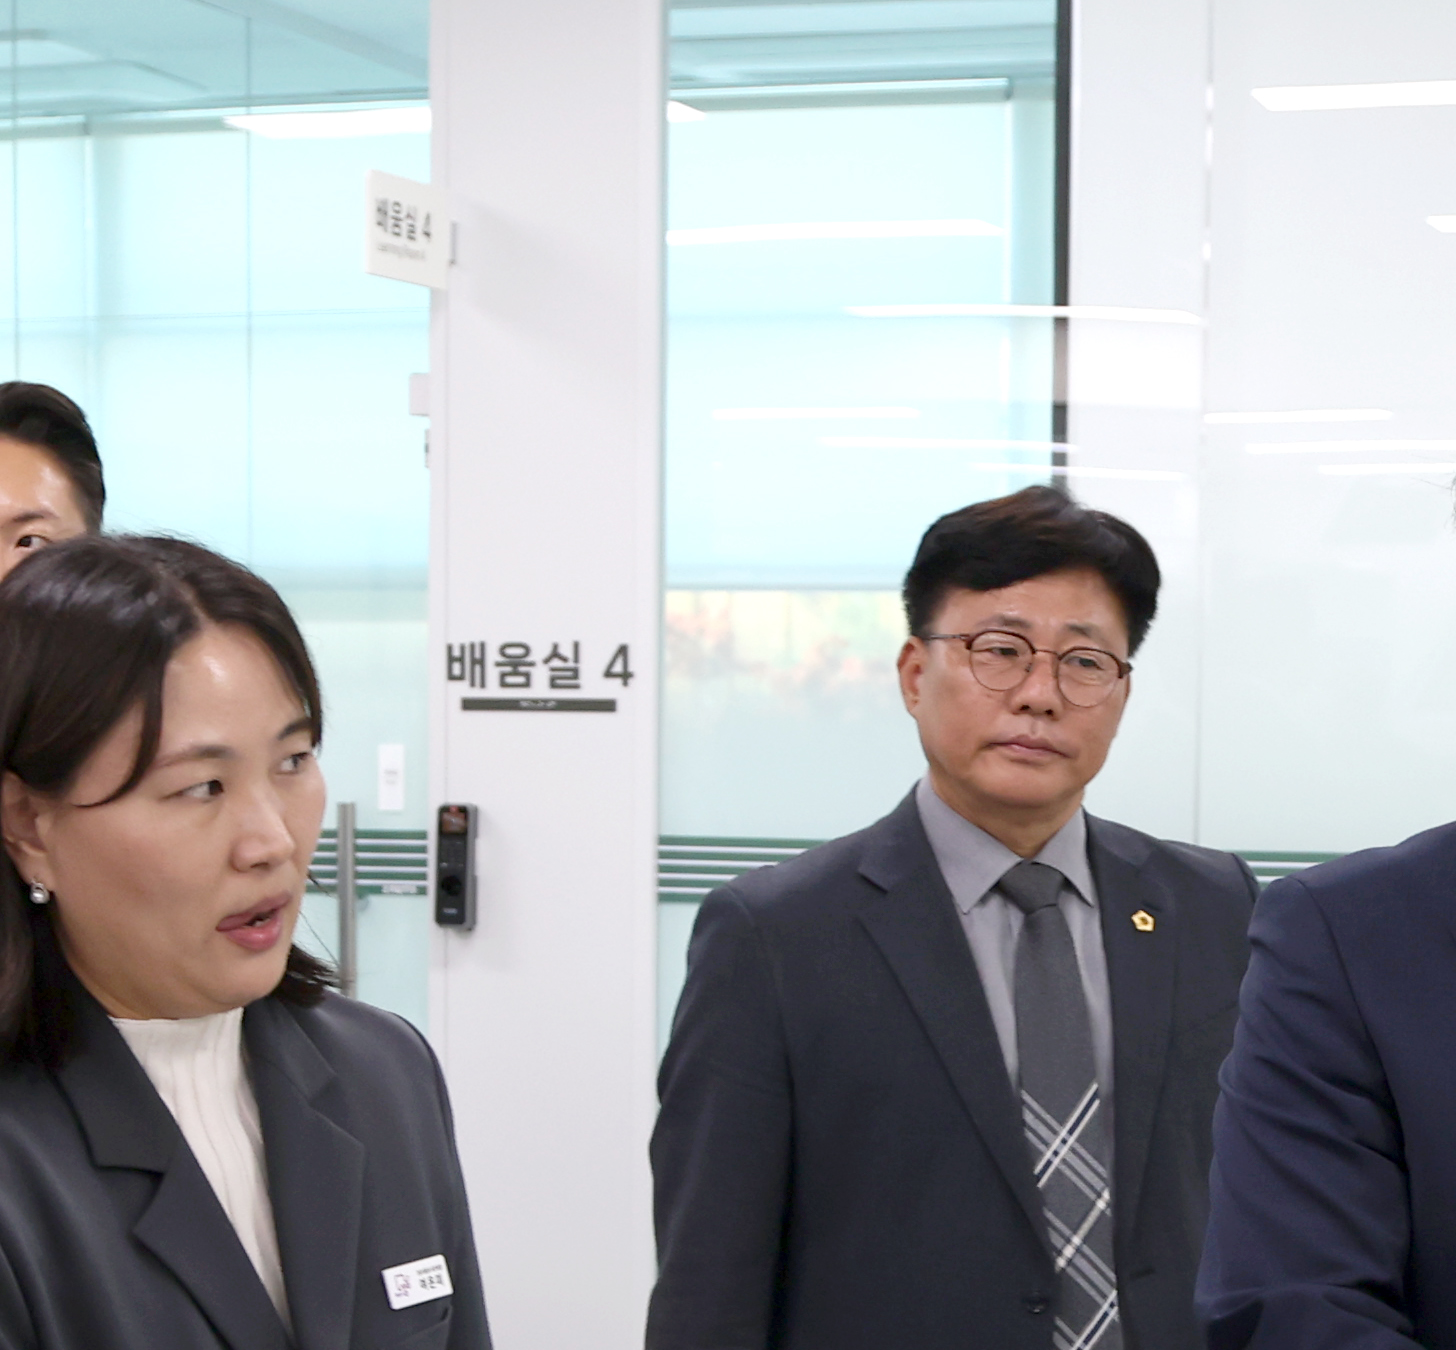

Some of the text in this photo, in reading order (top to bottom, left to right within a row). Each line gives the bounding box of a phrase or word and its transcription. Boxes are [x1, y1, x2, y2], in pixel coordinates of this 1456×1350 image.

[374, 198, 432, 242] 배움실 4
[446, 641, 634, 689] 배움실 4
